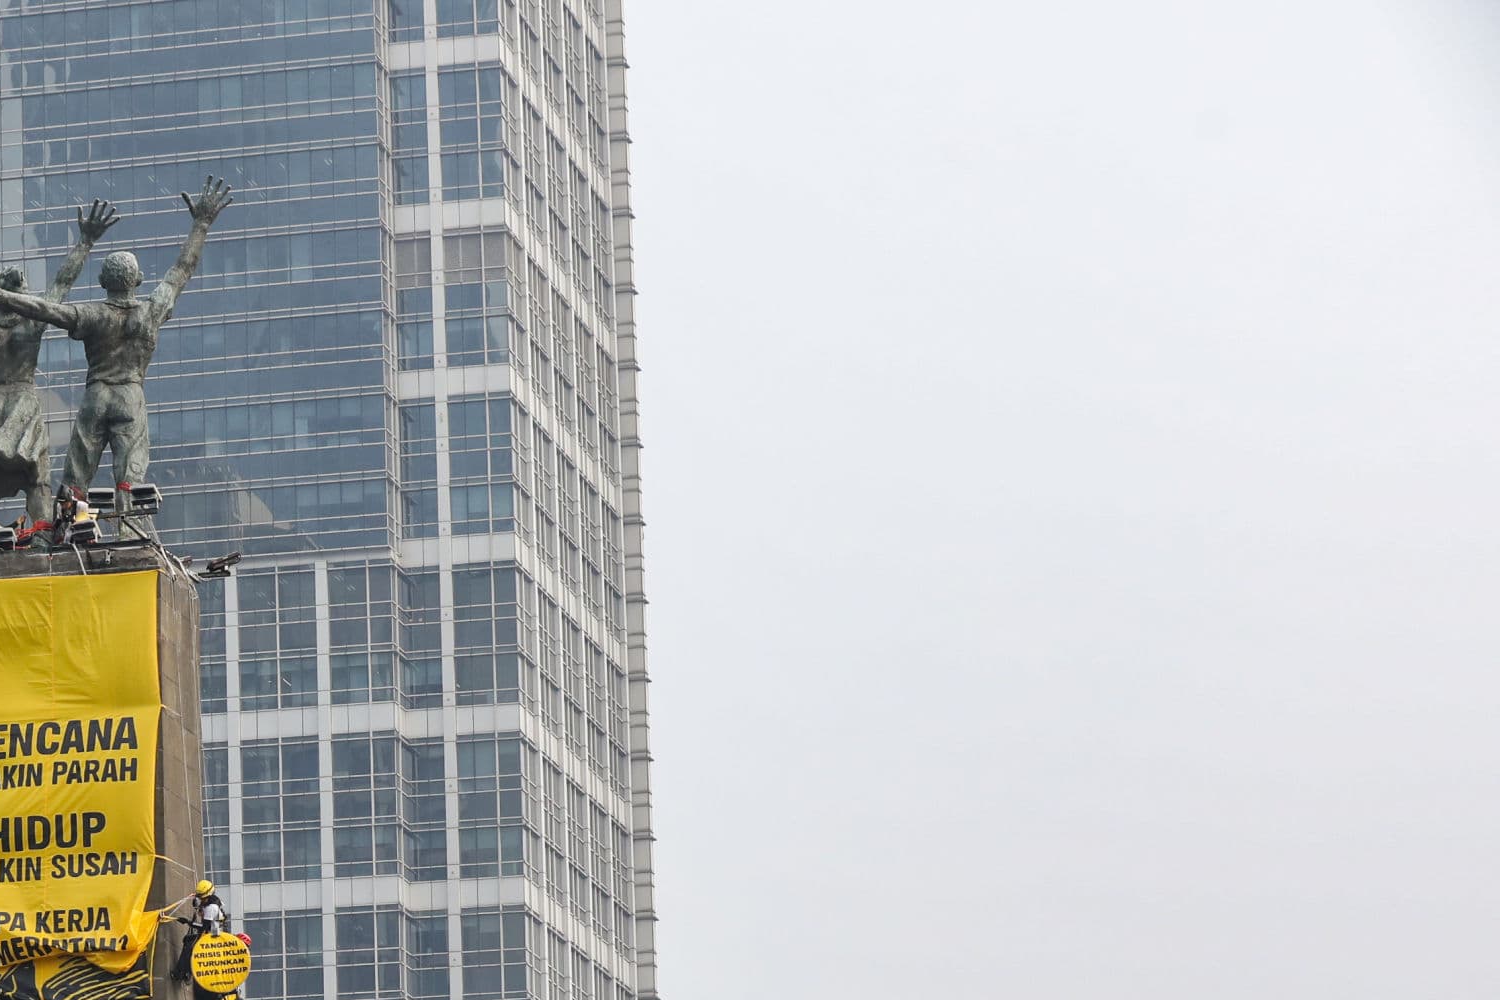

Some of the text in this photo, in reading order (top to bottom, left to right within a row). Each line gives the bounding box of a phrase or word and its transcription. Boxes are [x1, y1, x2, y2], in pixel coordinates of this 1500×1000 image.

[52, 758, 138, 785] PARAH
[51, 851, 137, 879] SUSAH
[35, 907, 111, 933] KERJA
[200, 941, 238, 949] TANGANI
[194, 949, 247, 959] KRISIS IKLIM
[197, 958, 245, 967] TURUNKAN
[221, 966, 248, 975] HIDUP
